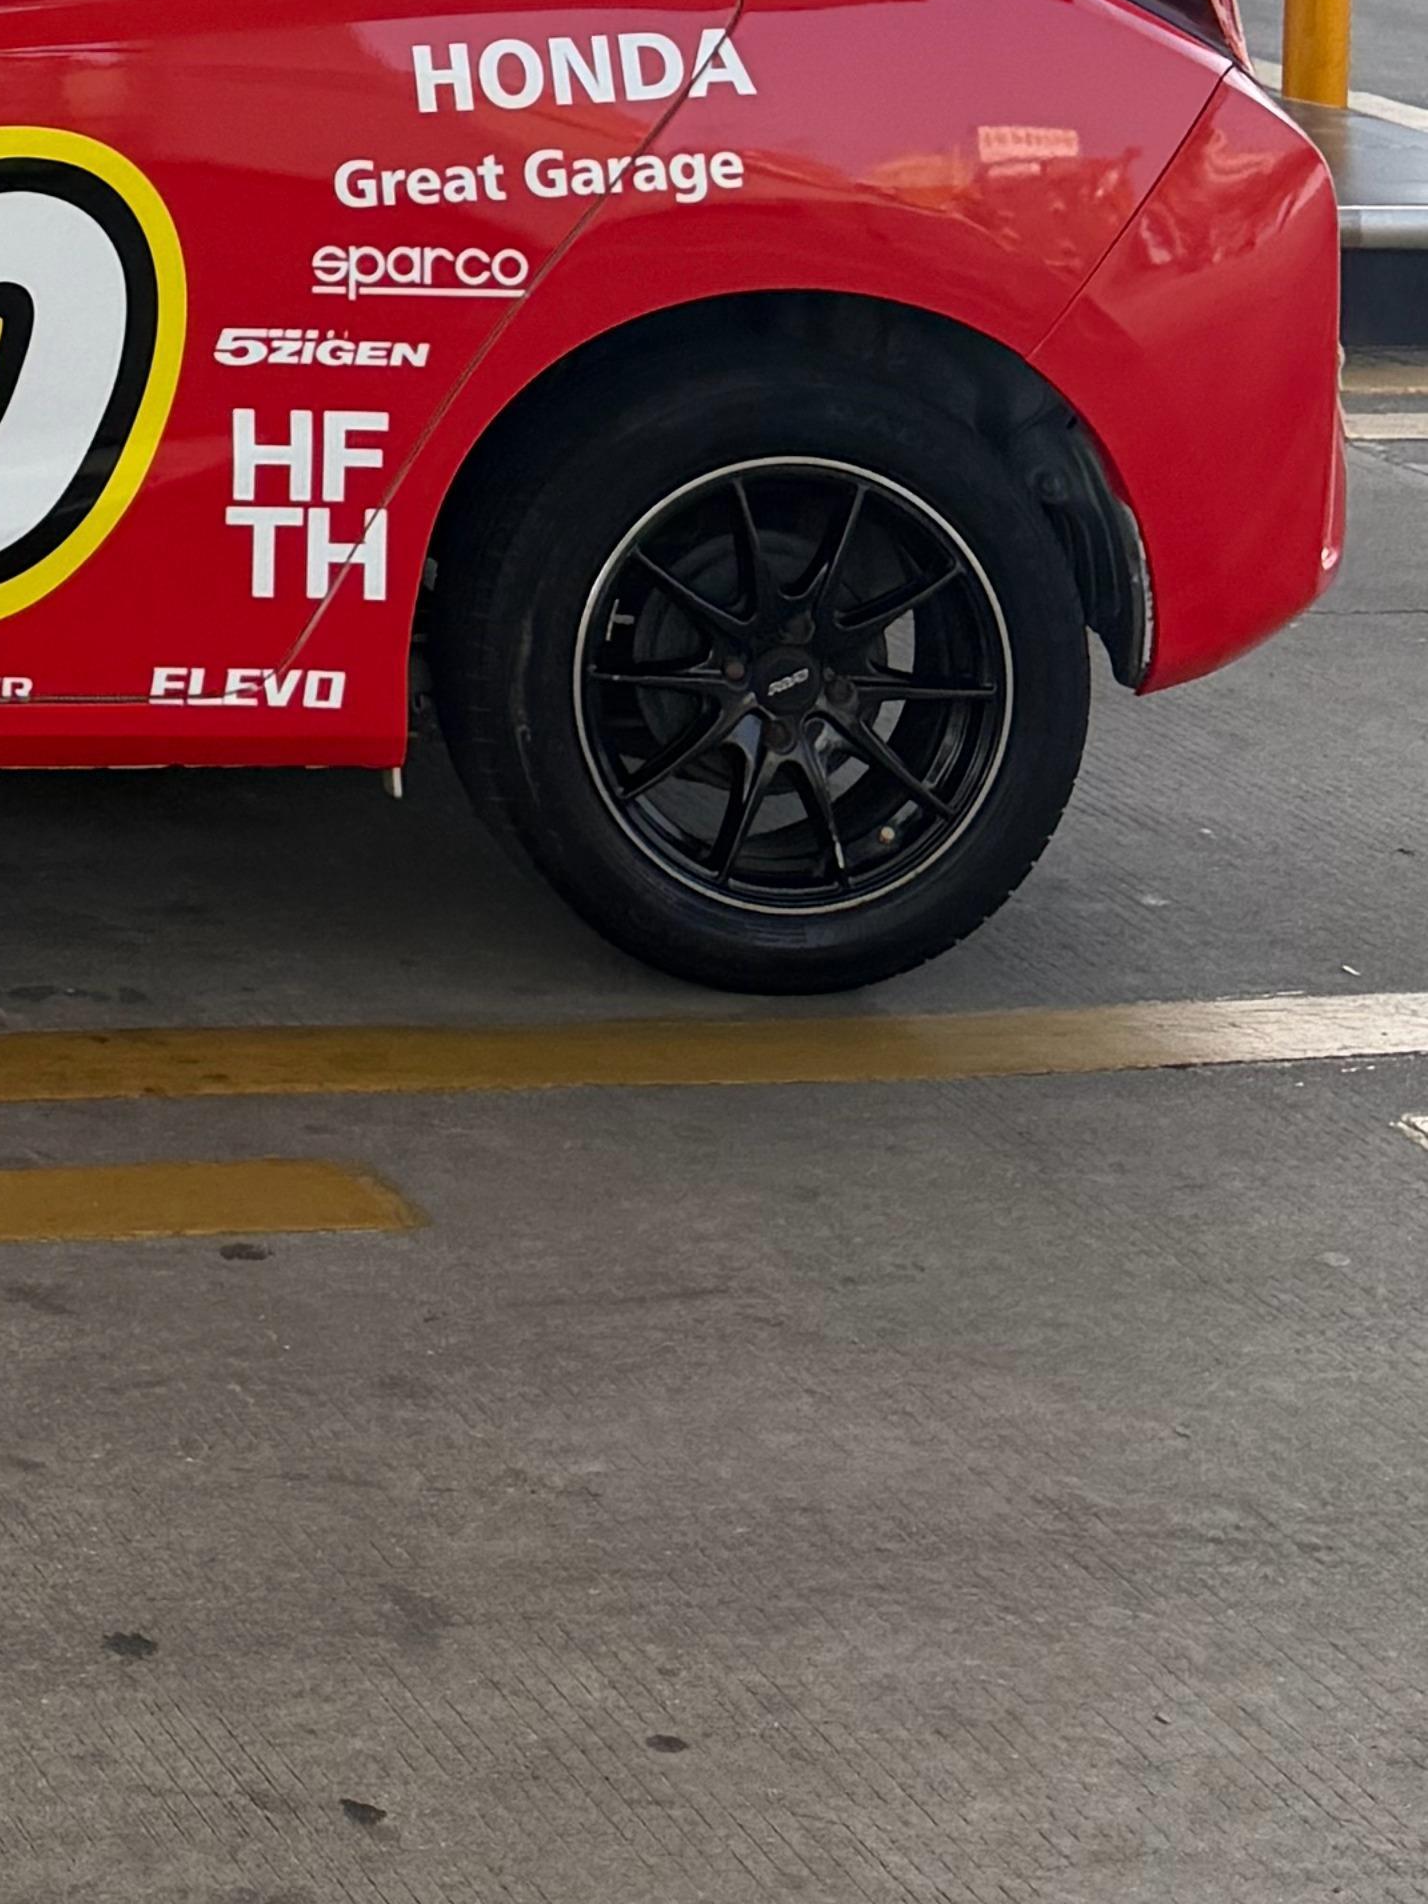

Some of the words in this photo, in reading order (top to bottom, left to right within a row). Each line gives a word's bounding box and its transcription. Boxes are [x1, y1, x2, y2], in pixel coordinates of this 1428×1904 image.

[412, 28, 757, 114] HONDA
[334, 154, 508, 209] Great
[524, 147, 745, 204] Garage
[312, 244, 529, 299] sparco
[232, 408, 390, 503] HF
[225, 506, 388, 601] TH
[148, 666, 347, 709] ELEVO
